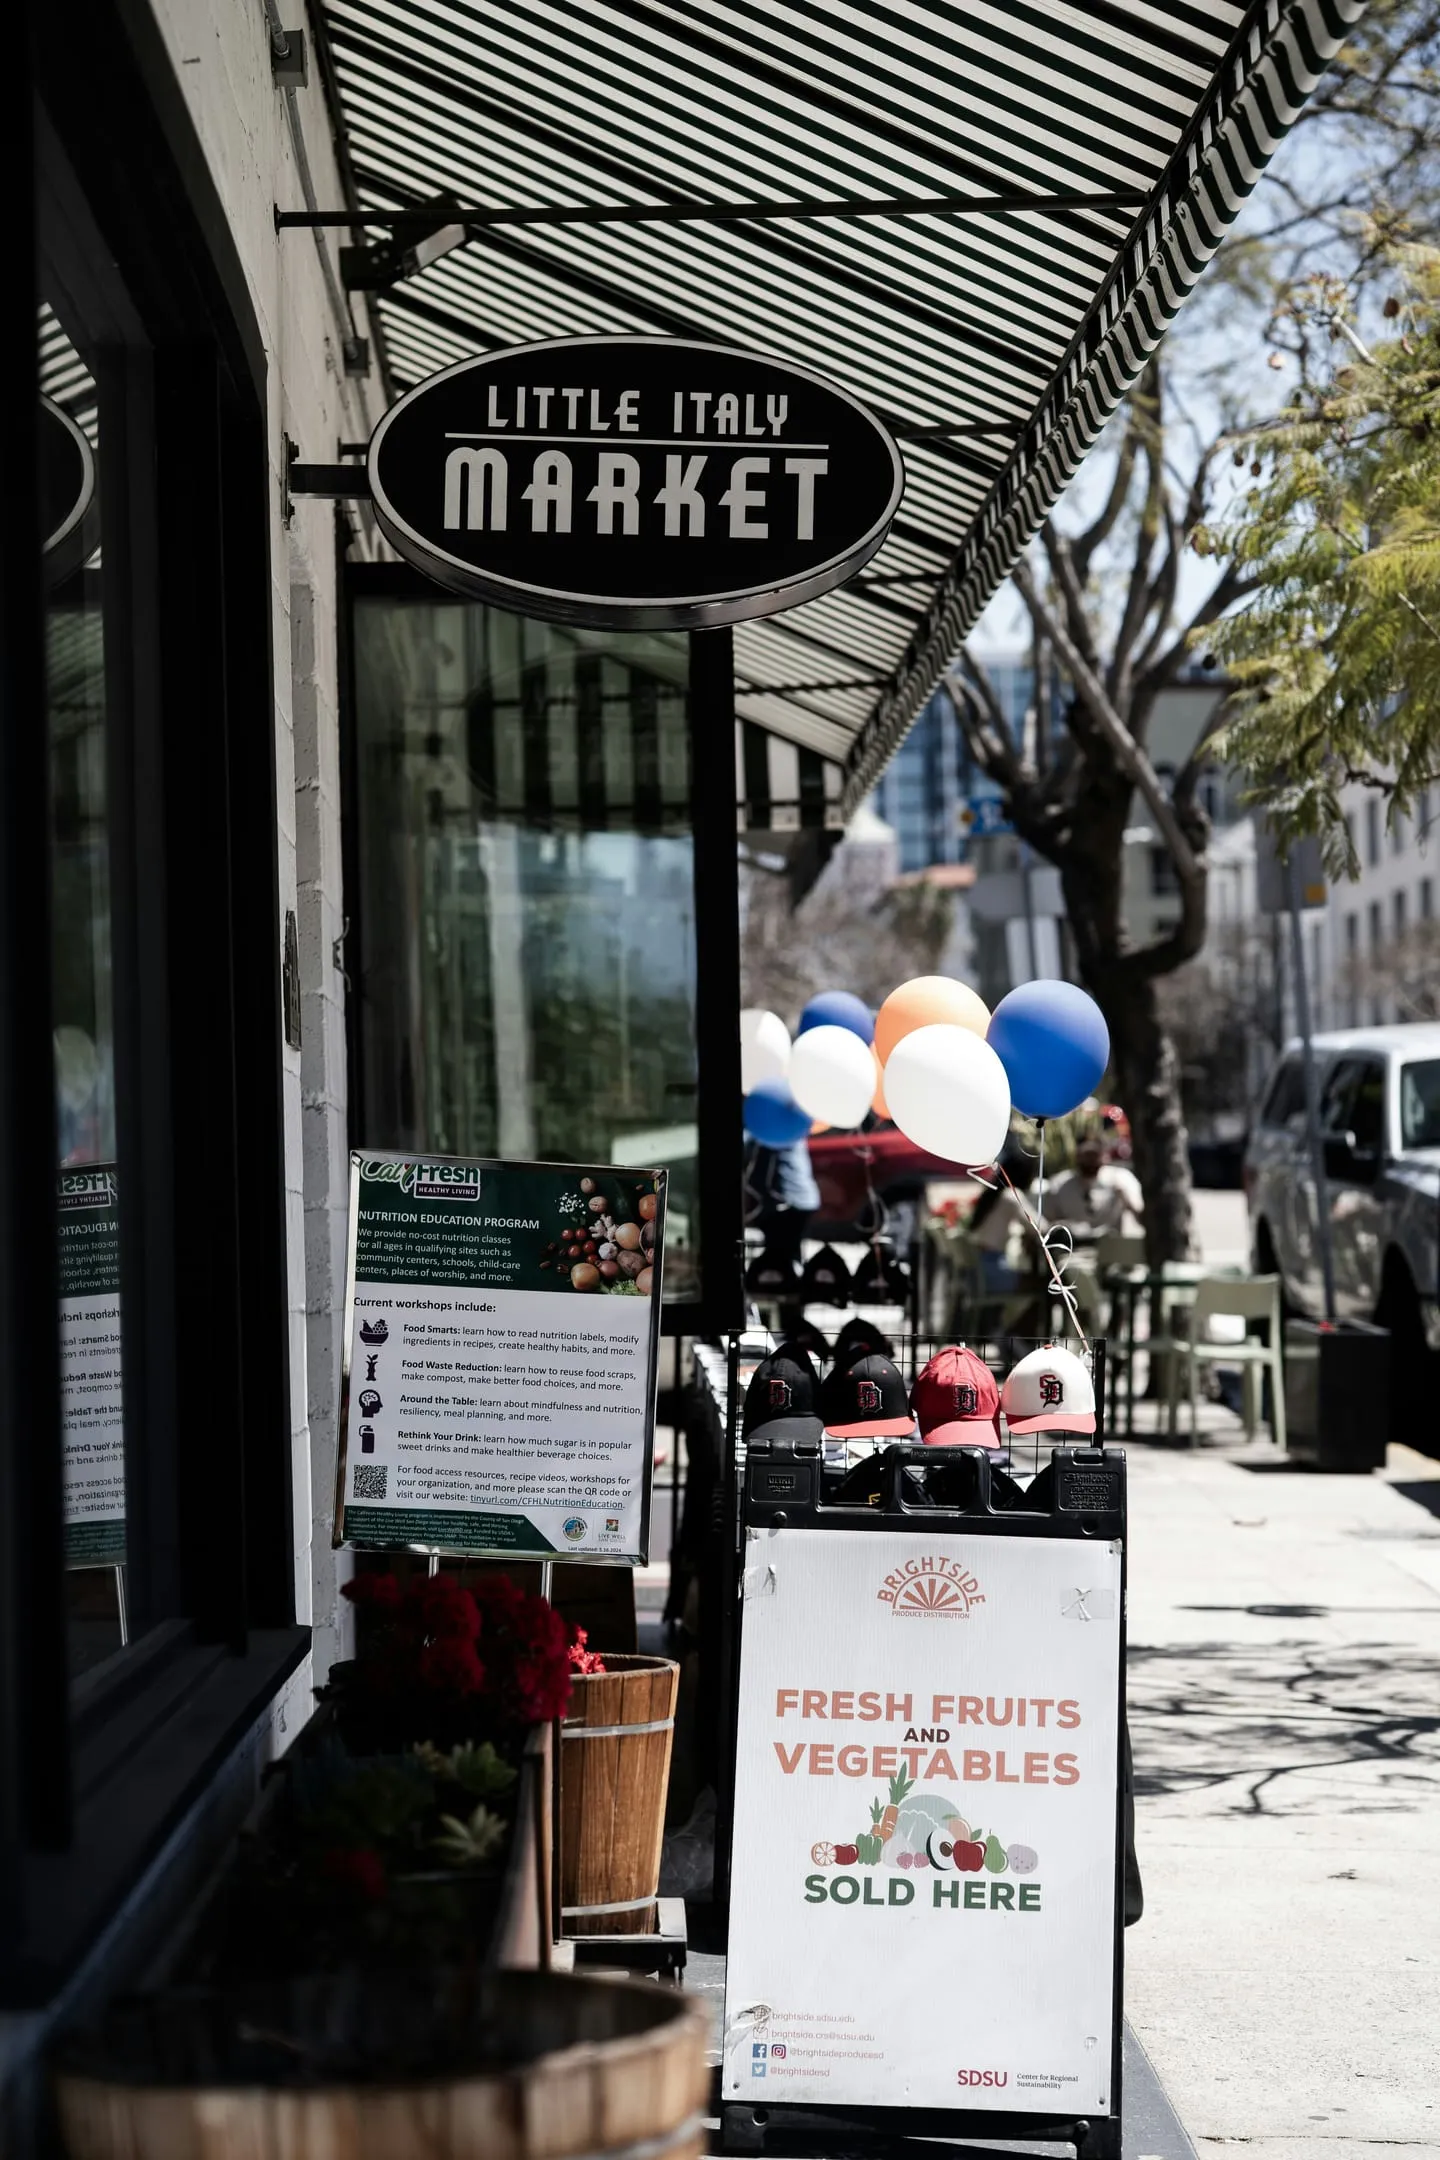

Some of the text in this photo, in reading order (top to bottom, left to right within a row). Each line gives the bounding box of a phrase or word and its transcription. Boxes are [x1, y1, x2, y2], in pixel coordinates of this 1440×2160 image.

[488, 386, 788, 436] LITTLE ITALY
[444, 446, 828, 540] MARKET
[358, 1210, 539, 1228] NUTRITION EDUCATION PROGRAM
[374, 1229, 406, 1239] provide
[442, 1232, 479, 1242] nutrition
[481, 1234, 510, 1244] classes
[383, 1243, 402, 1251] ages
[414, 1243, 456, 1255] qualifying
[458, 1246, 478, 1254] sites
[480, 1247, 500, 1255] such
[356, 1254, 520, 1269] community centers, schools, child-care
[356, 1266, 388, 1276] centers,
[391, 1267, 418, 1277] places
[420, 1268, 429, 1276] of
[431, 1269, 467, 1280] worship,
[470, 1271, 486, 1279] and
[354, 1297, 495, 1311] Current workshops include:
[403, 1336, 450, 1347] ingredients
[463, 1340, 495, 1349] recipes,
[527, 1343, 559, 1352] healthy
[562, 1344, 589, 1353] habits,
[540, 1331, 577, 1339] nutrition
[580, 1333, 607, 1342] labels,
[611, 1335, 639, 1344] modify
[455, 1363, 502, 1371] Reduction:
[586, 1369, 604, 1377] food
[427, 1374, 465, 1383] compost,
[494, 1376, 519, 1385] better
[523, 1377, 541, 1386] food
[544, 1379, 577, 1389] choices,
[400, 1407, 441, 1417] resiliency,
[467, 1410, 506, 1420] planning,
[452, 1397, 477, 1405] Table:
[531, 1401, 582, 1410] mindfulness
[604, 1403, 643, 1415] nutrition,
[528, 1437, 552, 1445] much
[599, 1441, 632, 1451] popular
[496, 1448, 535, 1457] healthier
[537, 1450, 575, 1460] beverage
[579, 1452, 611, 1460] choices.
[464, 1472, 508, 1480] resources,
[570, 1474, 615, 1485] workshops
[418, 1480, 472, 1490] organization,
[518, 1485, 544, 1494] please
[585, 1487, 596, 1495] QR
[600, 1488, 619, 1496] code
[432, 1492, 468, 1500] website:
[877, 1556, 985, 1605] BRIGHTSIDE
[776, 1689, 1081, 1728] FRESH FRUITS
[904, 1728, 950, 1743] AND
[774, 1742, 1081, 1785] VEGETABLES
[804, 1875, 1041, 1911] SOLD HERE
[773, 2011, 855, 2023] brightside.sdsu.edu
[790, 2047, 884, 2059] @brightsideproducesd
[771, 2066, 830, 2077] @brightsidesd
[958, 2070, 1007, 2087] SDSU
[1017, 2081, 1061, 2089] Sustainability
